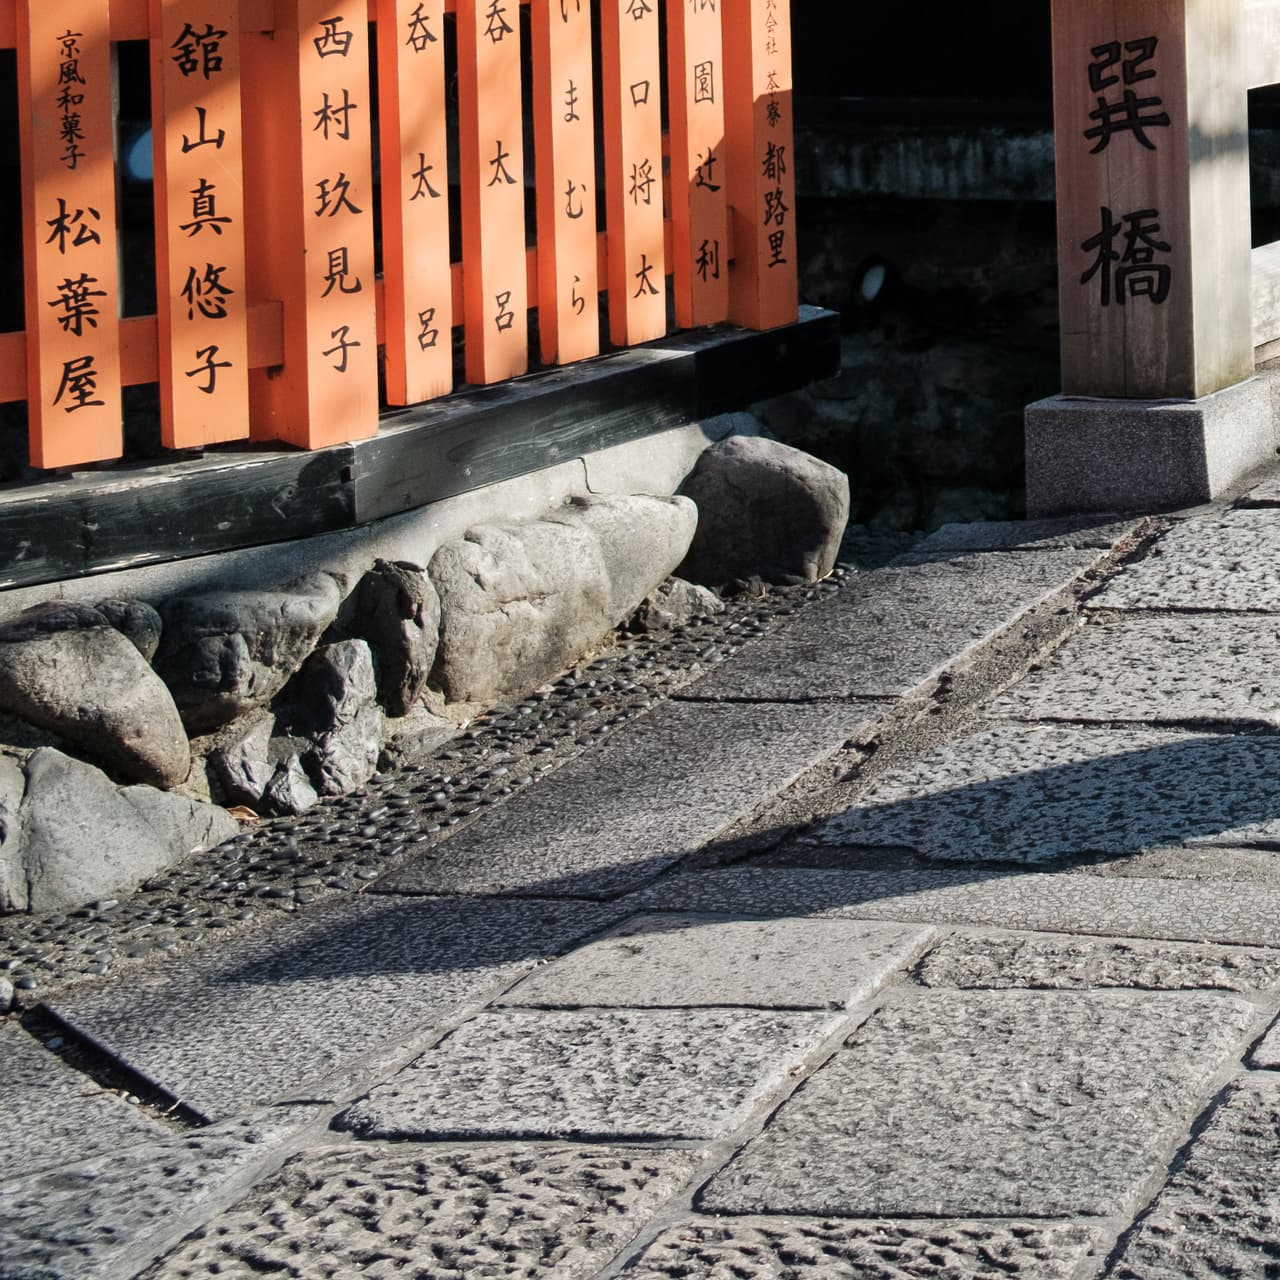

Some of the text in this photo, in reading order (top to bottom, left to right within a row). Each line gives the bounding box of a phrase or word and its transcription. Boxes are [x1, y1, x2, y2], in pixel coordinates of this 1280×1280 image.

[45, 28, 107, 414] 京風和菓子 松葉屋
[170, 22, 236, 395] 舘山真悠子
[312, 15, 364, 374] 西村玖見子
[405, 2, 442, 352] 呑太呂
[762, 141, 789, 269] 都路里
[1079, 35, 1173, 307] 巽橋
